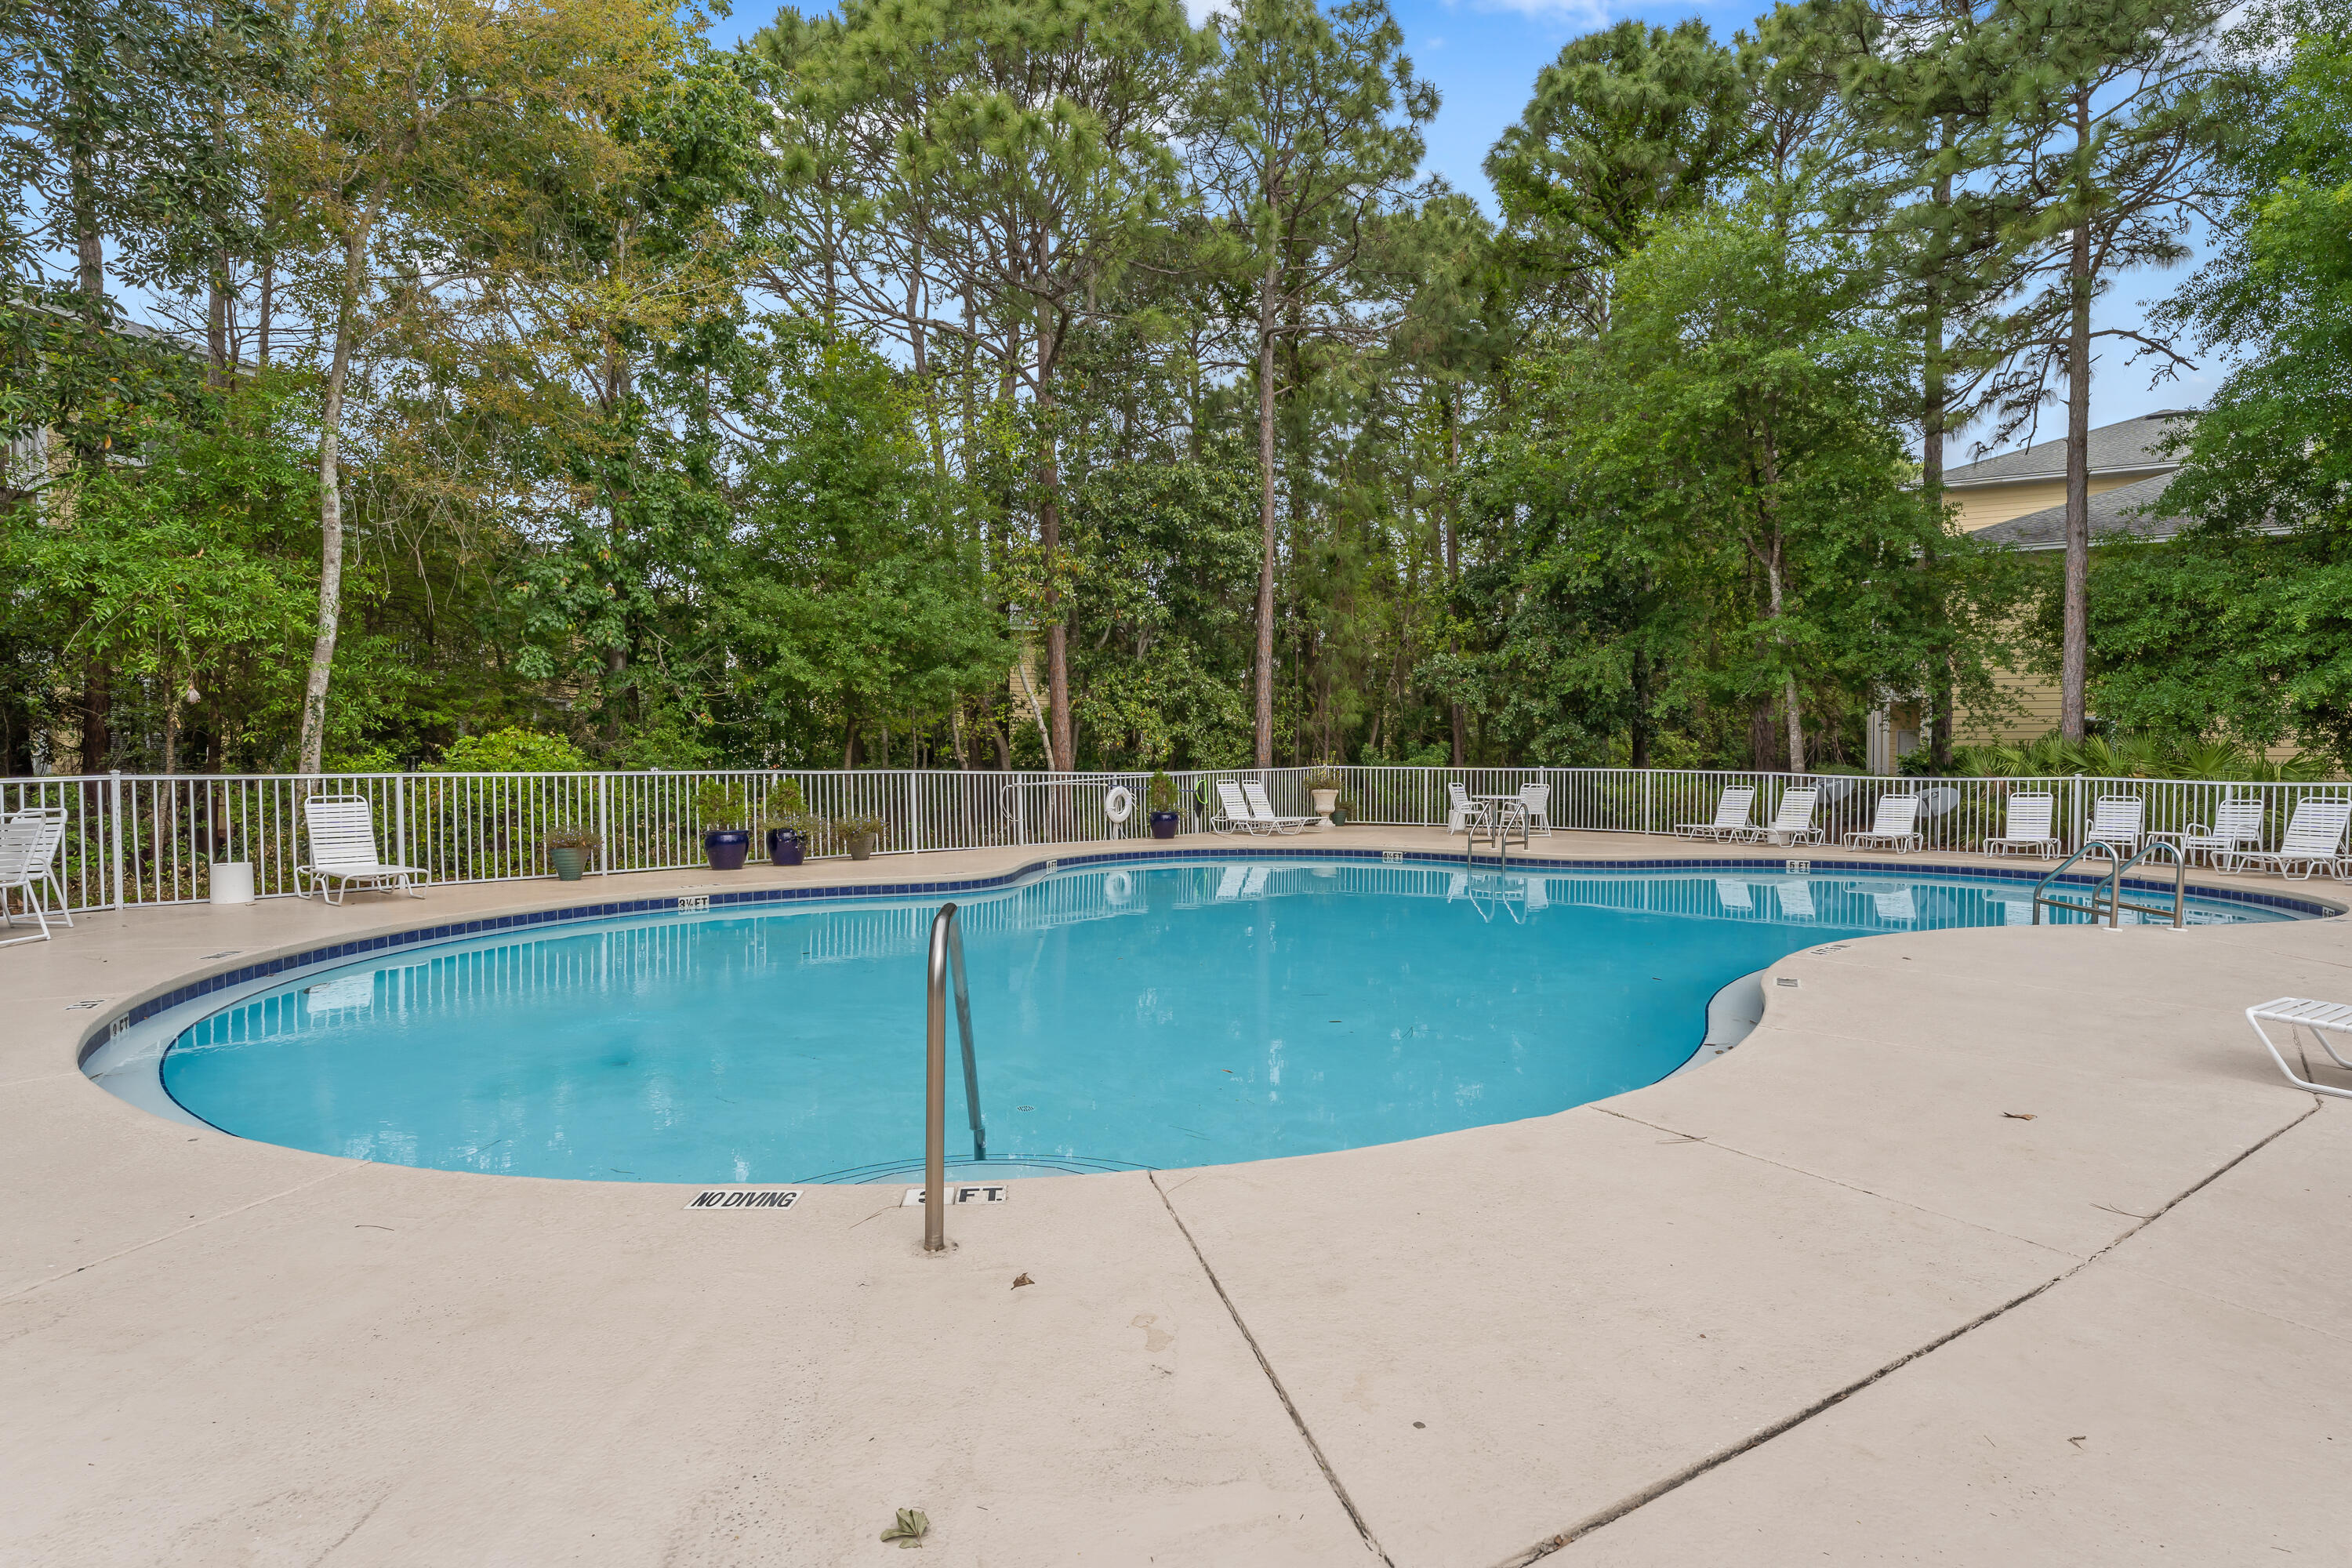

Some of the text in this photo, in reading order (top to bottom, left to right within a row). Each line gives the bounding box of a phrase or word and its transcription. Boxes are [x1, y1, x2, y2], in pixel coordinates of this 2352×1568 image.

[695, 897, 708, 907] FT
[119, 1015, 129, 1033] FT
[690, 1192, 797, 1207] NO DIVING
[958, 1187, 1004, 1203] FT.
